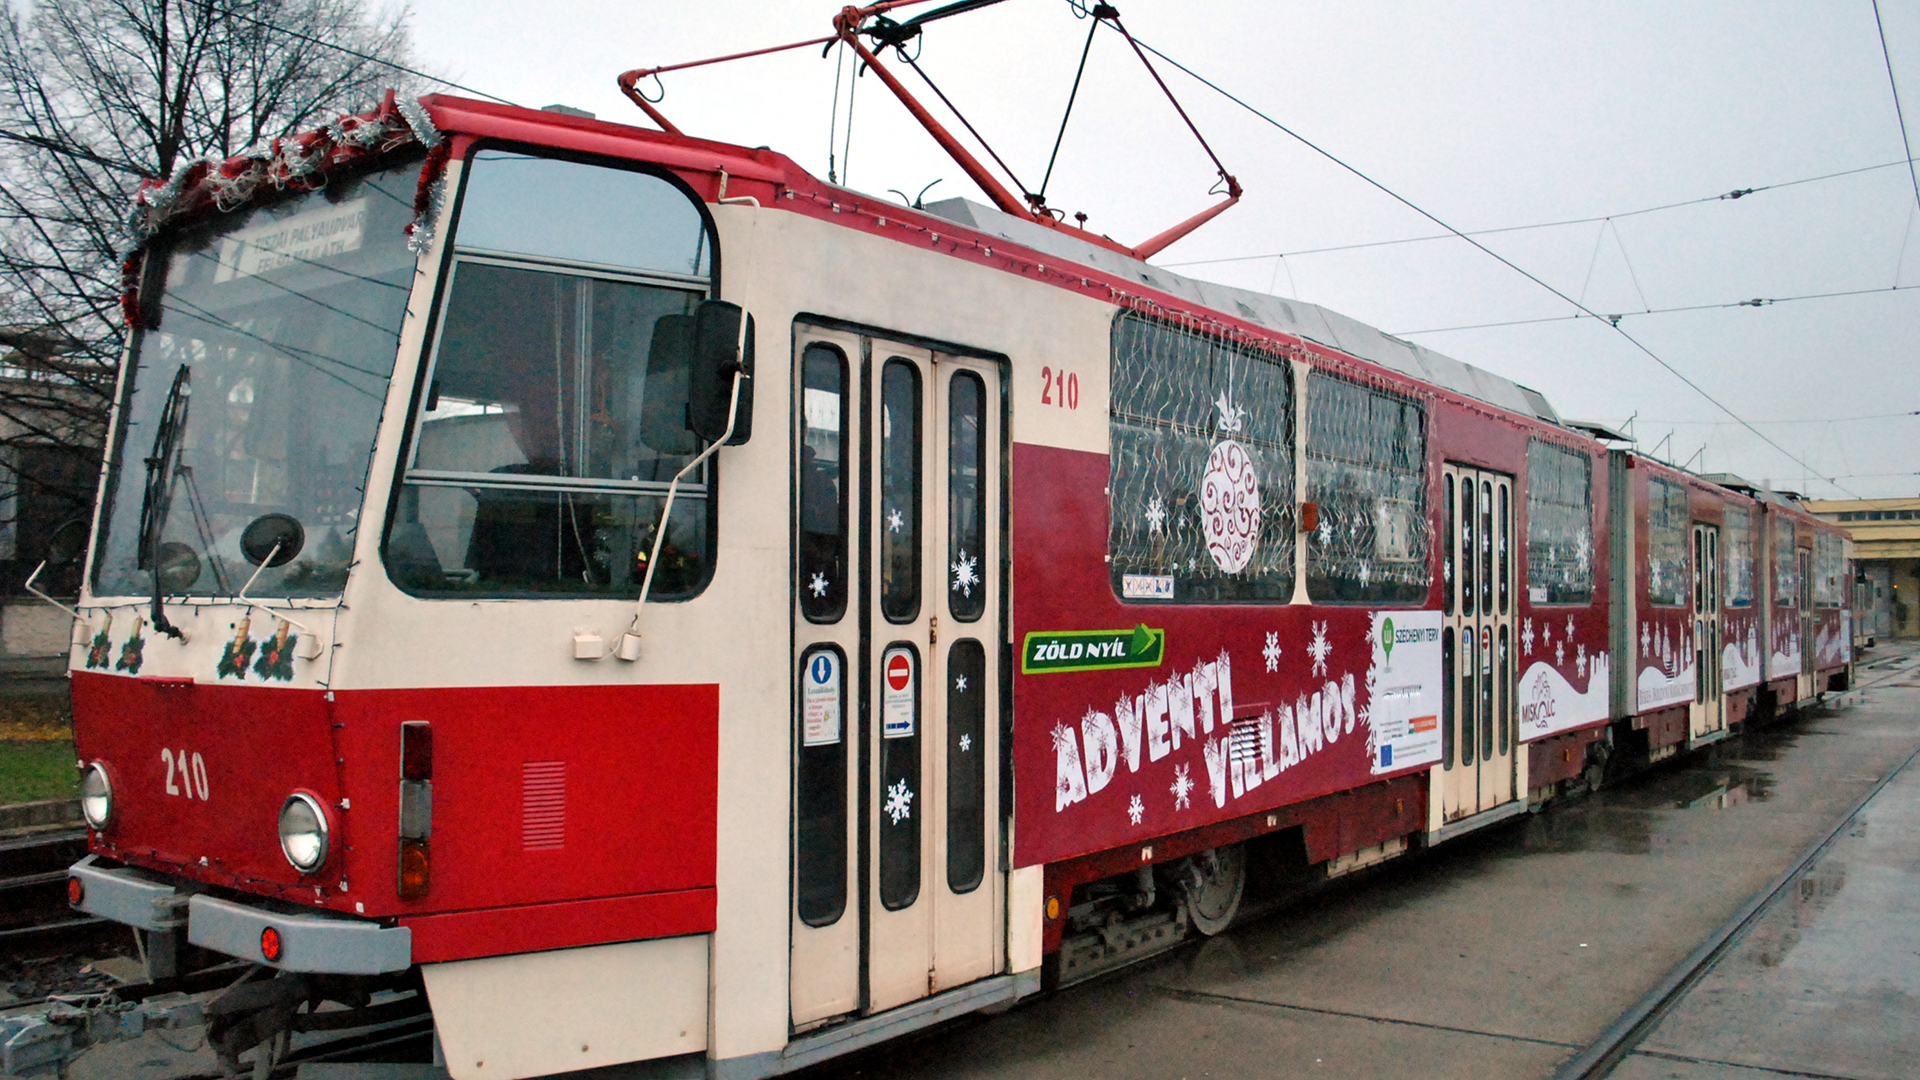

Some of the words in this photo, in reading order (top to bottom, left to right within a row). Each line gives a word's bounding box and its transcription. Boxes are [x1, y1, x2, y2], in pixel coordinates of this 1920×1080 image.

[1041, 365, 1079, 411] 210
[1033, 640, 1083, 661] ZÖLD
[1086, 637, 1126, 658] NYÍL
[1425, 628, 1439, 642] TERV
[1053, 650, 1233, 813] ADVENTI
[1203, 671, 1356, 809] VILLAMOS
[161, 747, 210, 802] 210
